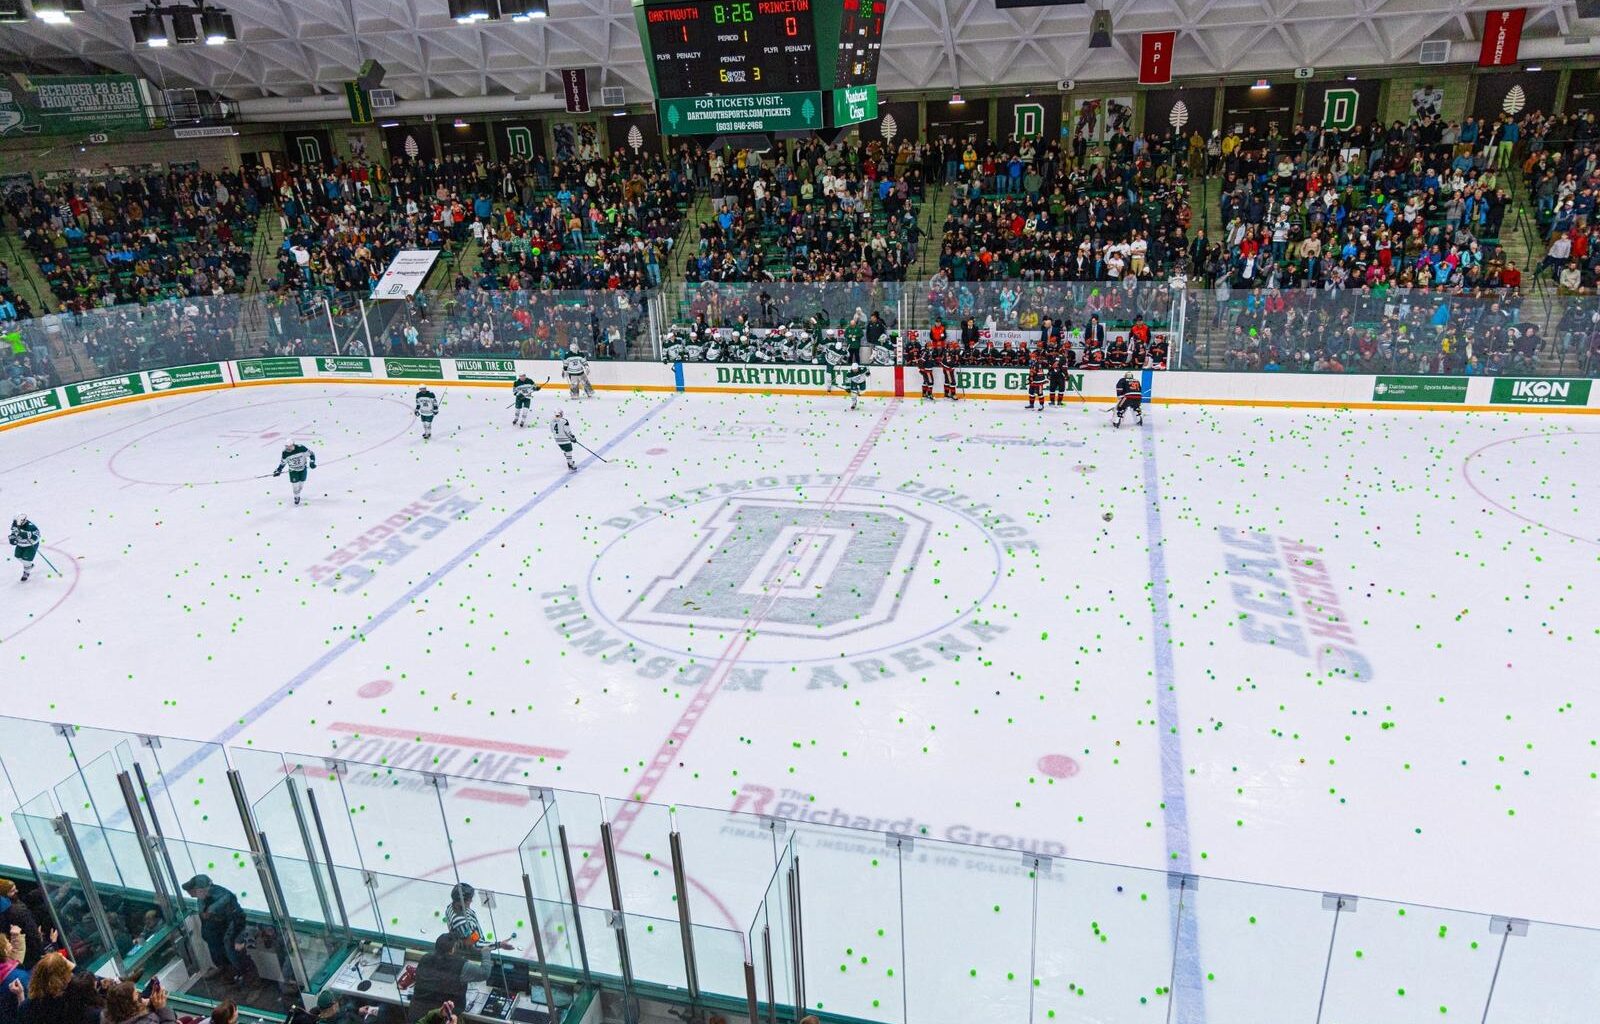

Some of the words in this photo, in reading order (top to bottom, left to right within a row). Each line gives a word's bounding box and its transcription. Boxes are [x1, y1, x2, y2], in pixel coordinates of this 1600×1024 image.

[648, 8, 698, 22] DARTMOUTH
[714, 3, 754, 24] 8:26
[758, 0, 809, 14] PRINCETON
[682, 26, 688, 42] 1
[744, 30, 748, 42] 1
[786, 17, 798, 36] 0
[1154, 42, 1162, 75] RPI
[720, 69, 727, 82] 6
[753, 68, 760, 81] 3
[94, 84, 108, 94] 28
[120, 82, 134, 92] 29
[1062, 81, 1070, 90] 6
[40, 94, 100, 108] THOMPSON
[102, 92, 138, 105] ARENA
[695, 100, 714, 109] FOR
[716, 98, 754, 108] TICKETS
[756, 96, 783, 107] VISIT:
[1321, 88, 1360, 132] D
[687, 108, 791, 120] DARTMOUTHSPORTS.COM/TICKETS
[1014, 103, 1045, 144] D
[716, 122, 732, 131] (603)
[506, 126, 534, 162] D
[456, 360, 482, 370] WILSON
[486, 361, 500, 370] TIRE
[957, 372, 996, 390] BIG
[1005, 372, 1084, 392] GRN
[1512, 380, 1570, 398] IKON
[0, 396, 48, 417] OWNLINE
[553, 423, 559, 434] 4
[601, 474, 883, 530] DARTMOUTH
[895, 480, 1041, 552] COLLEGE
[304, 502, 432, 581] HOCKEY
[321, 495, 483, 594] ECAC
[617, 496, 932, 640] D
[1218, 524, 1312, 658] ECAC
[1278, 536, 1358, 646] HOCKEY
[540, 584, 769, 692] THOMPSON
[804, 618, 1010, 690] ARENA
[330, 736, 533, 783] TOWNLINE
[731, 784, 776, 816] R
[780, 788, 812, 801] The
[773, 801, 930, 837] Richards
[945, 824, 1067, 857] Group
[967, 860, 1066, 882] SOLUTNS
